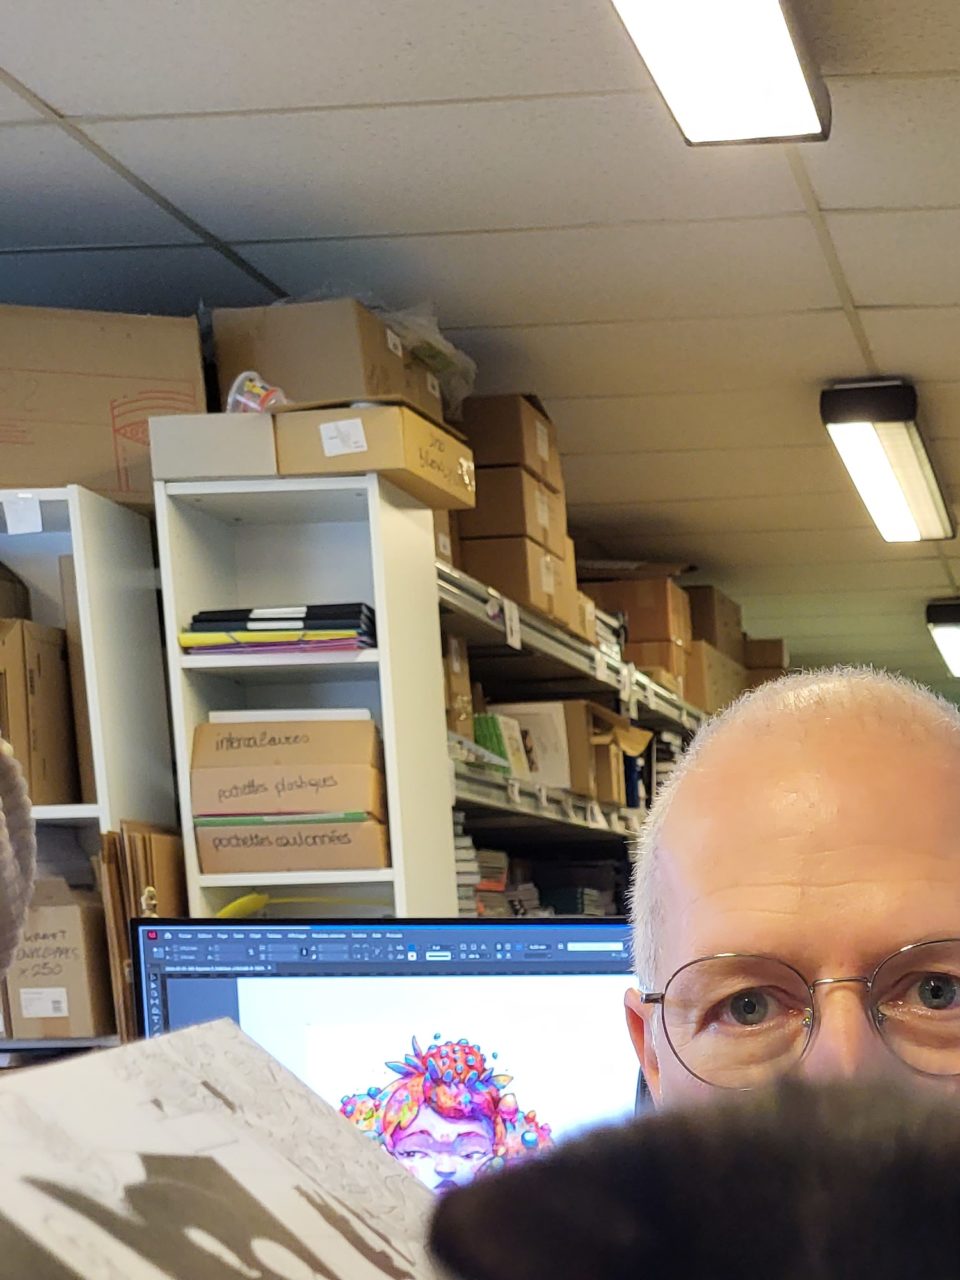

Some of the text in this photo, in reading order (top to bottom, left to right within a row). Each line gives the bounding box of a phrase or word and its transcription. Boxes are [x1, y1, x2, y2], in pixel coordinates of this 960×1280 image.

[216, 732, 309, 751] intercalaires
[218, 775, 337, 802] pochettes plastiques
[212, 833, 273, 852] pochettes
